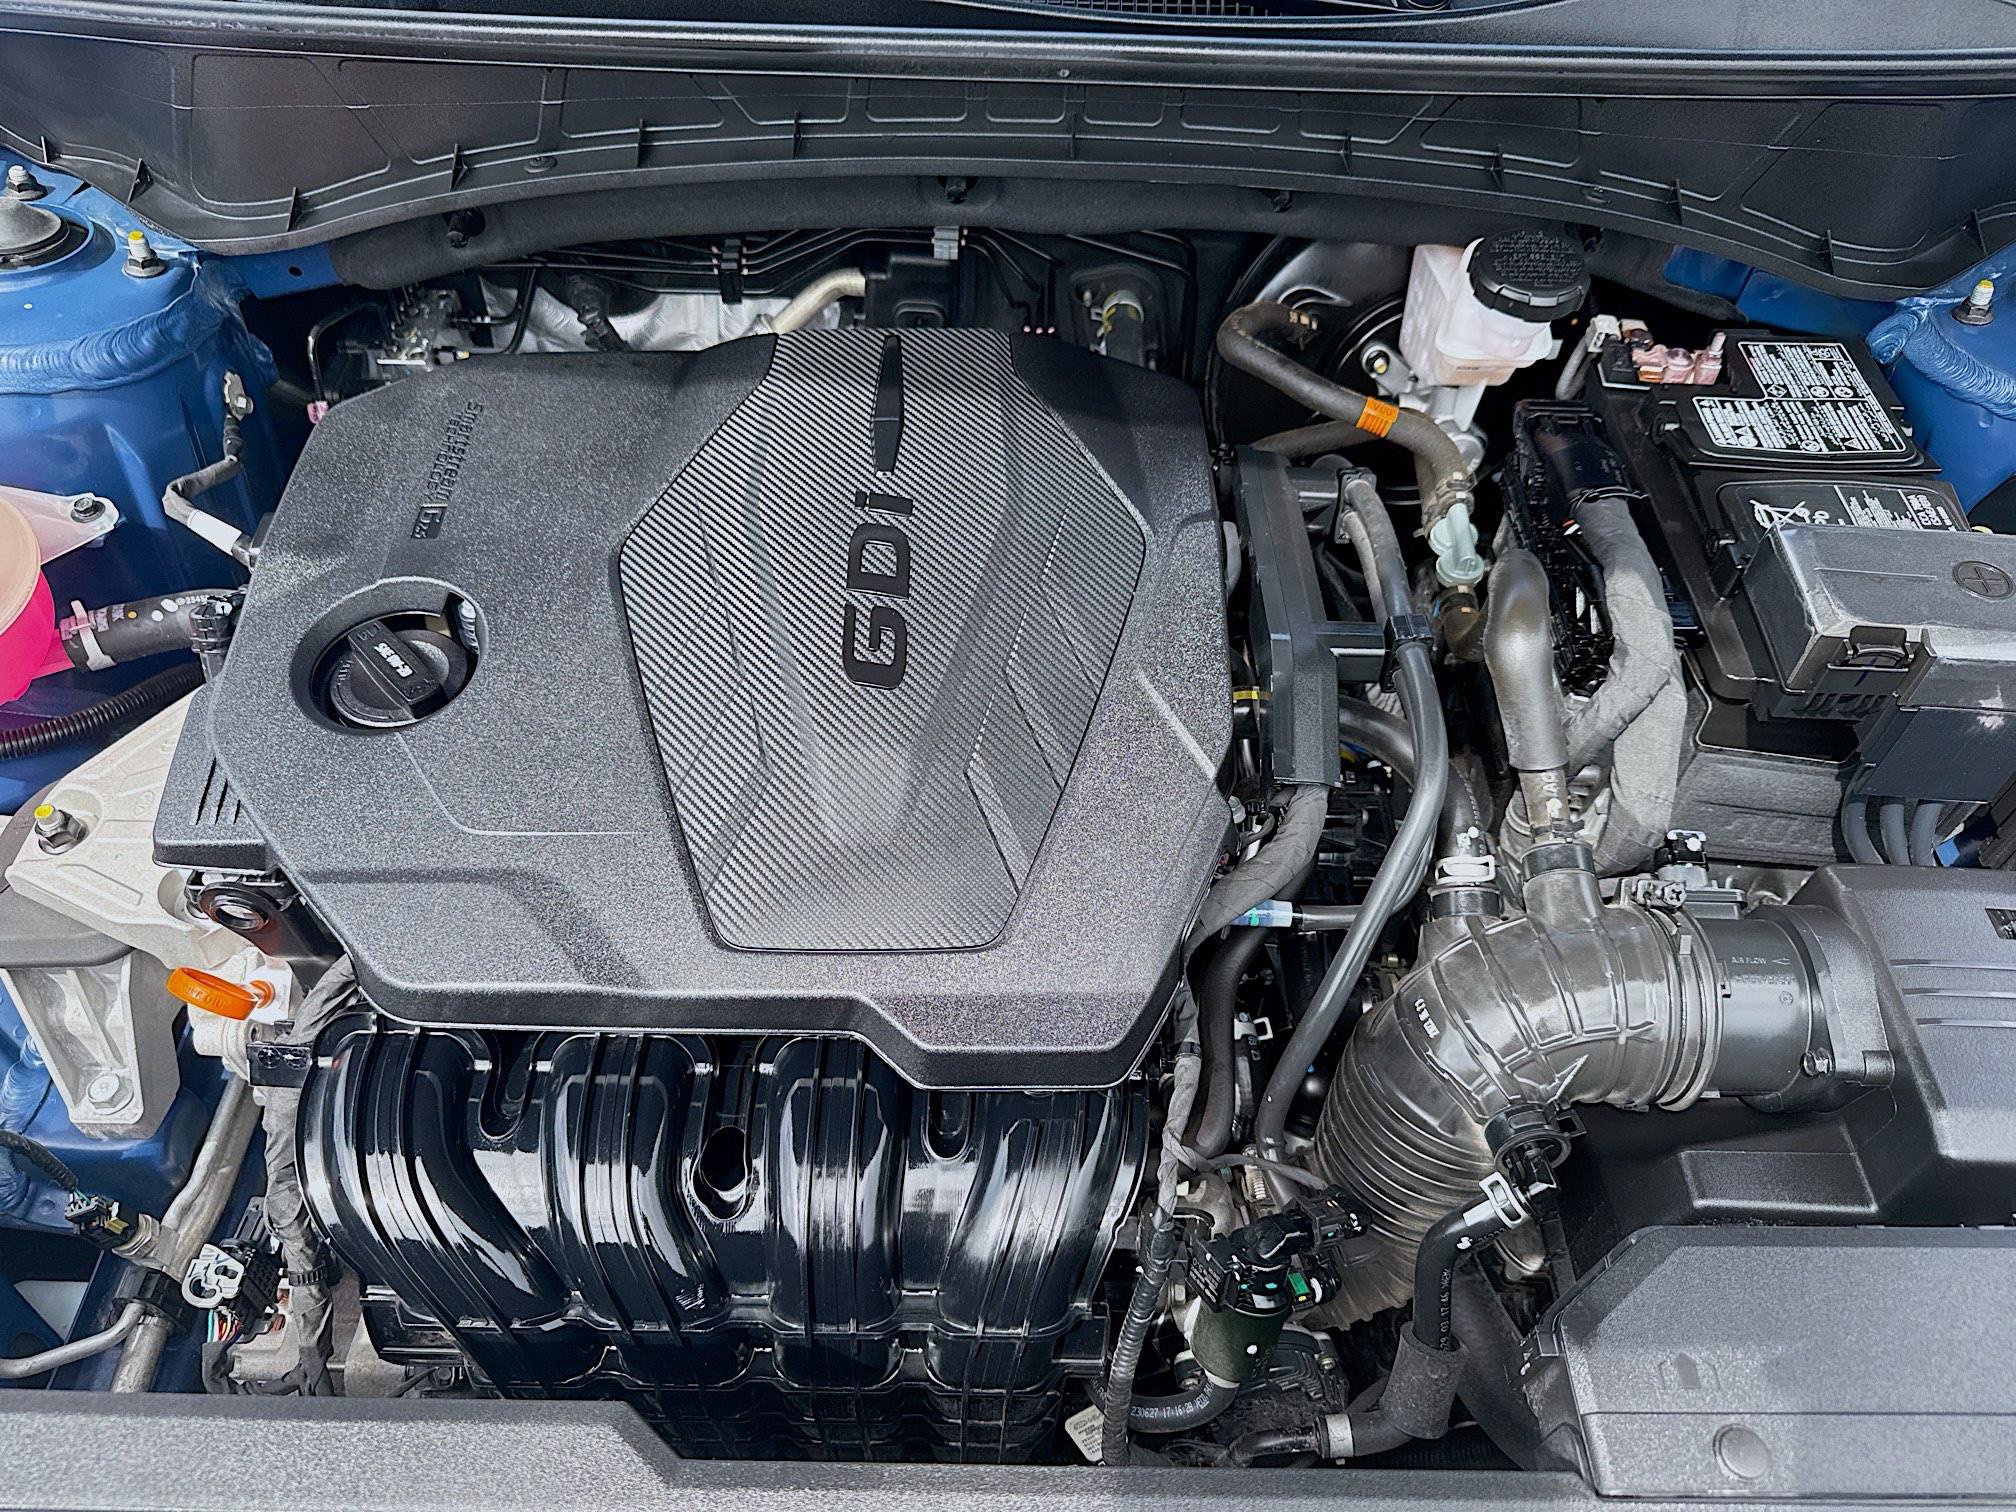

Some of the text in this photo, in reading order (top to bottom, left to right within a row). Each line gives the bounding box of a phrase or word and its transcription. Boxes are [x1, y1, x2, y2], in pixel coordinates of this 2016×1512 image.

[424, 411, 462, 501] TECHNOLOGY
[436, 401, 483, 500] Smartstream
[841, 489, 912, 691] GDi
[1130, 1406, 1159, 1418] 230627
